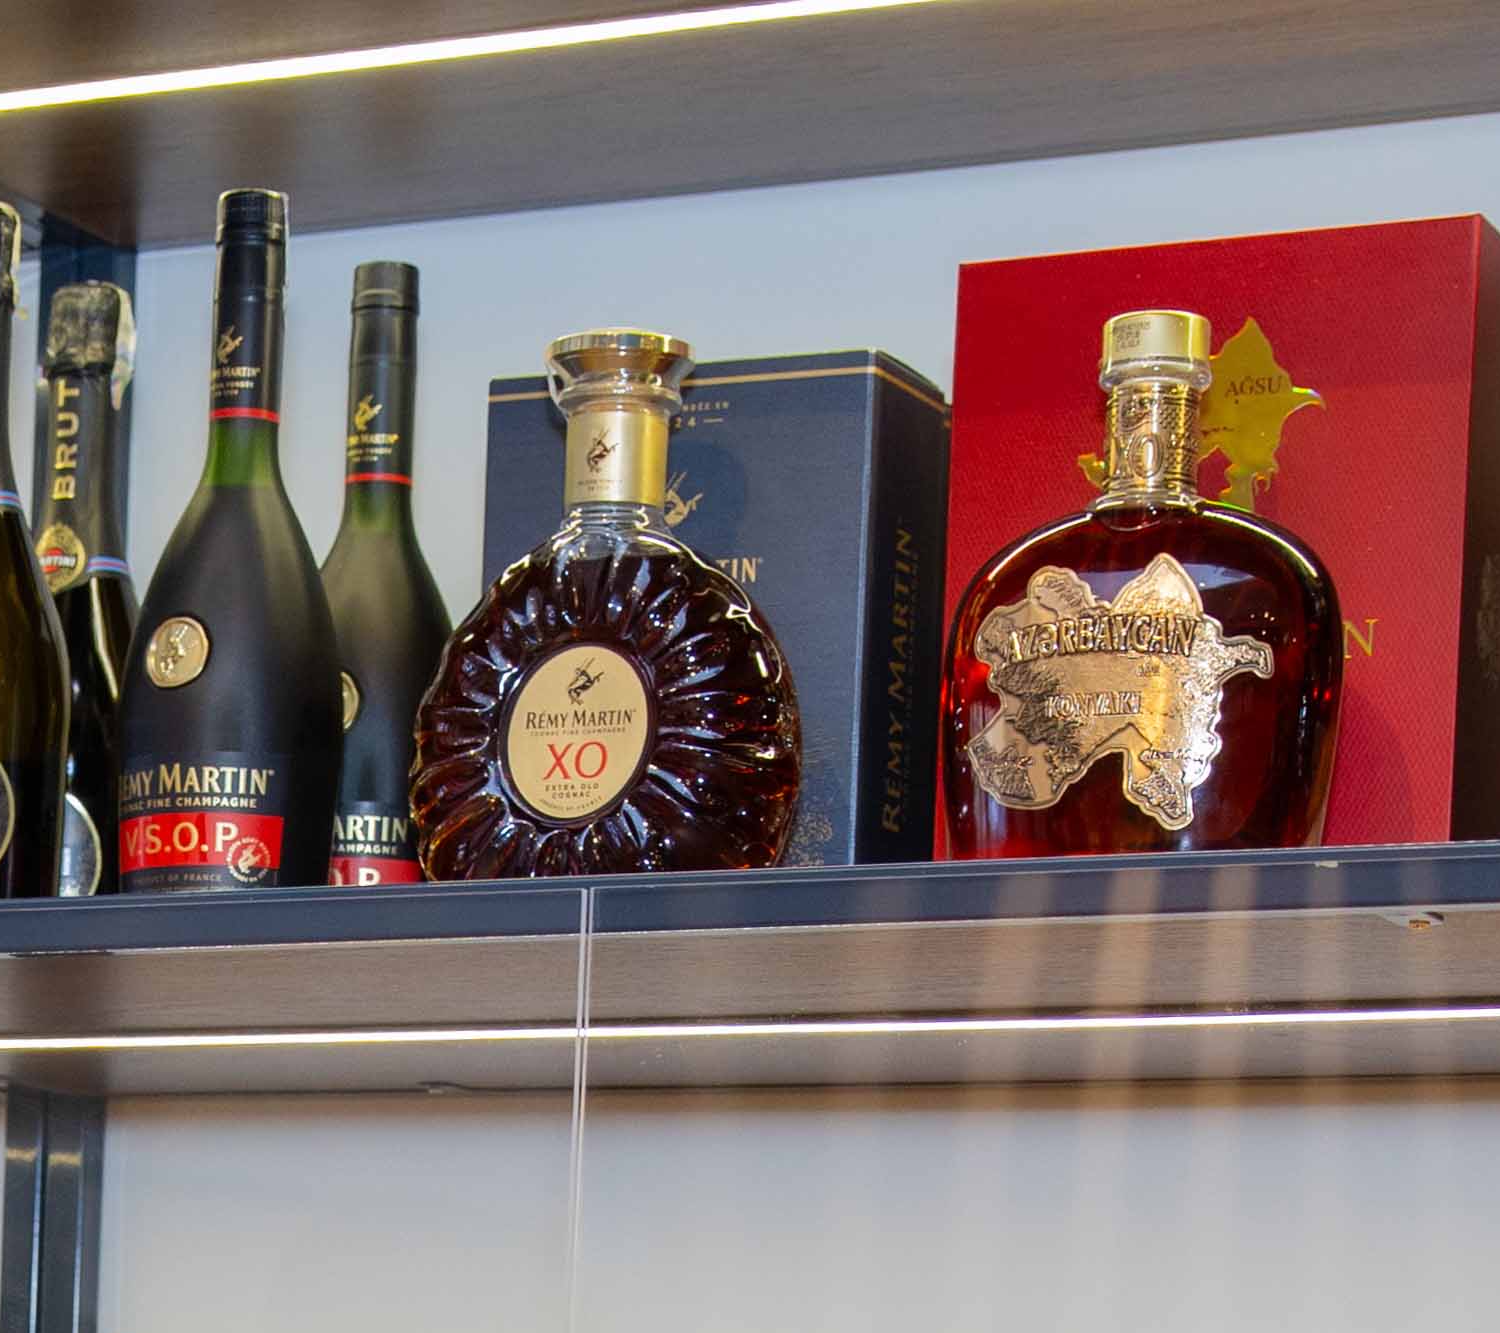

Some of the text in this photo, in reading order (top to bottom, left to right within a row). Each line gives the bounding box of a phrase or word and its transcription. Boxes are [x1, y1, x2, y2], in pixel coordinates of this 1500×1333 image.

[53, 379, 81, 501] BRUT
[39, 554, 76, 568] ARTINI
[889, 527, 914, 700] MARTIN
[526, 708, 633, 730] RÉMY MARTIN
[544, 741, 609, 780] XO
[158, 763, 268, 796] MARTIN
[545, 784, 575, 792] EXTRA
[176, 796, 257, 809] CHAMPAGNE
[333, 815, 409, 843] ARTIN
[338, 843, 397, 856] AMPAGNE
